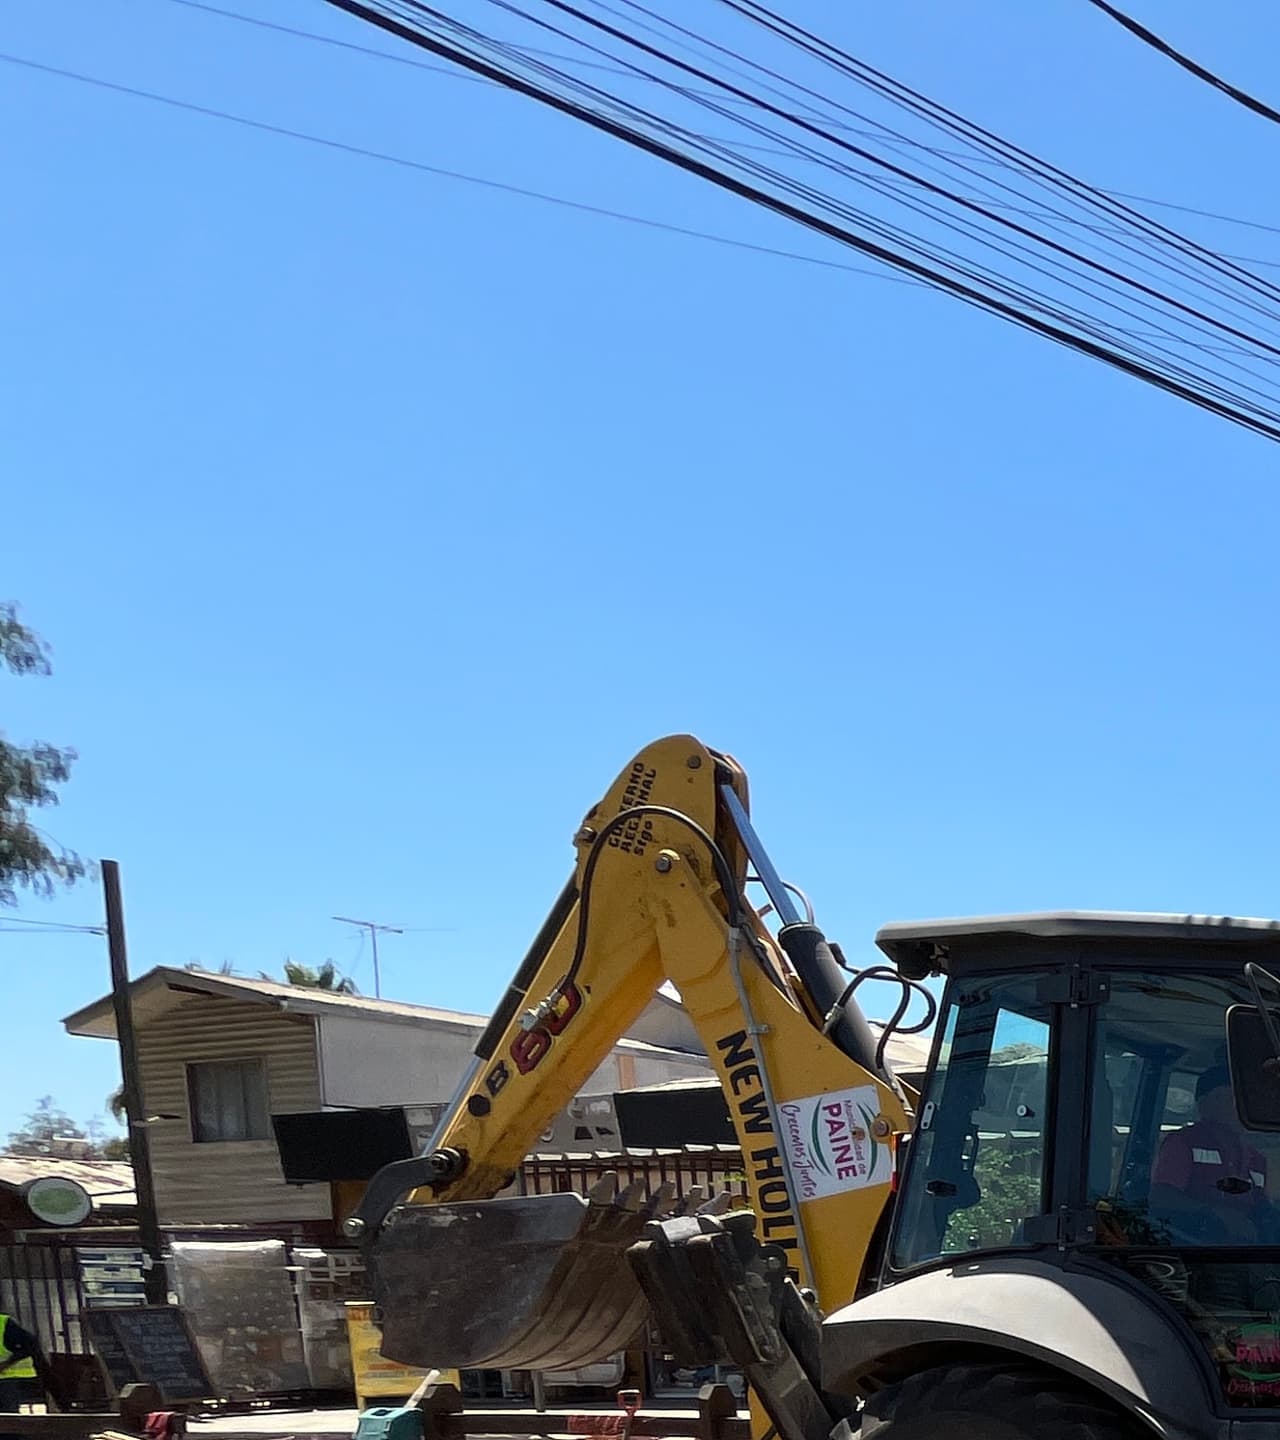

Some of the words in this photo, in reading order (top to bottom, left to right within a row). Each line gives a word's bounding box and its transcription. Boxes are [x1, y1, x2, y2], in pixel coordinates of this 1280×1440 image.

[717, 1030, 771, 1133] NEW
[792, 1159, 817, 1198] Juntos
[822, 1103, 858, 1181] PAINE
